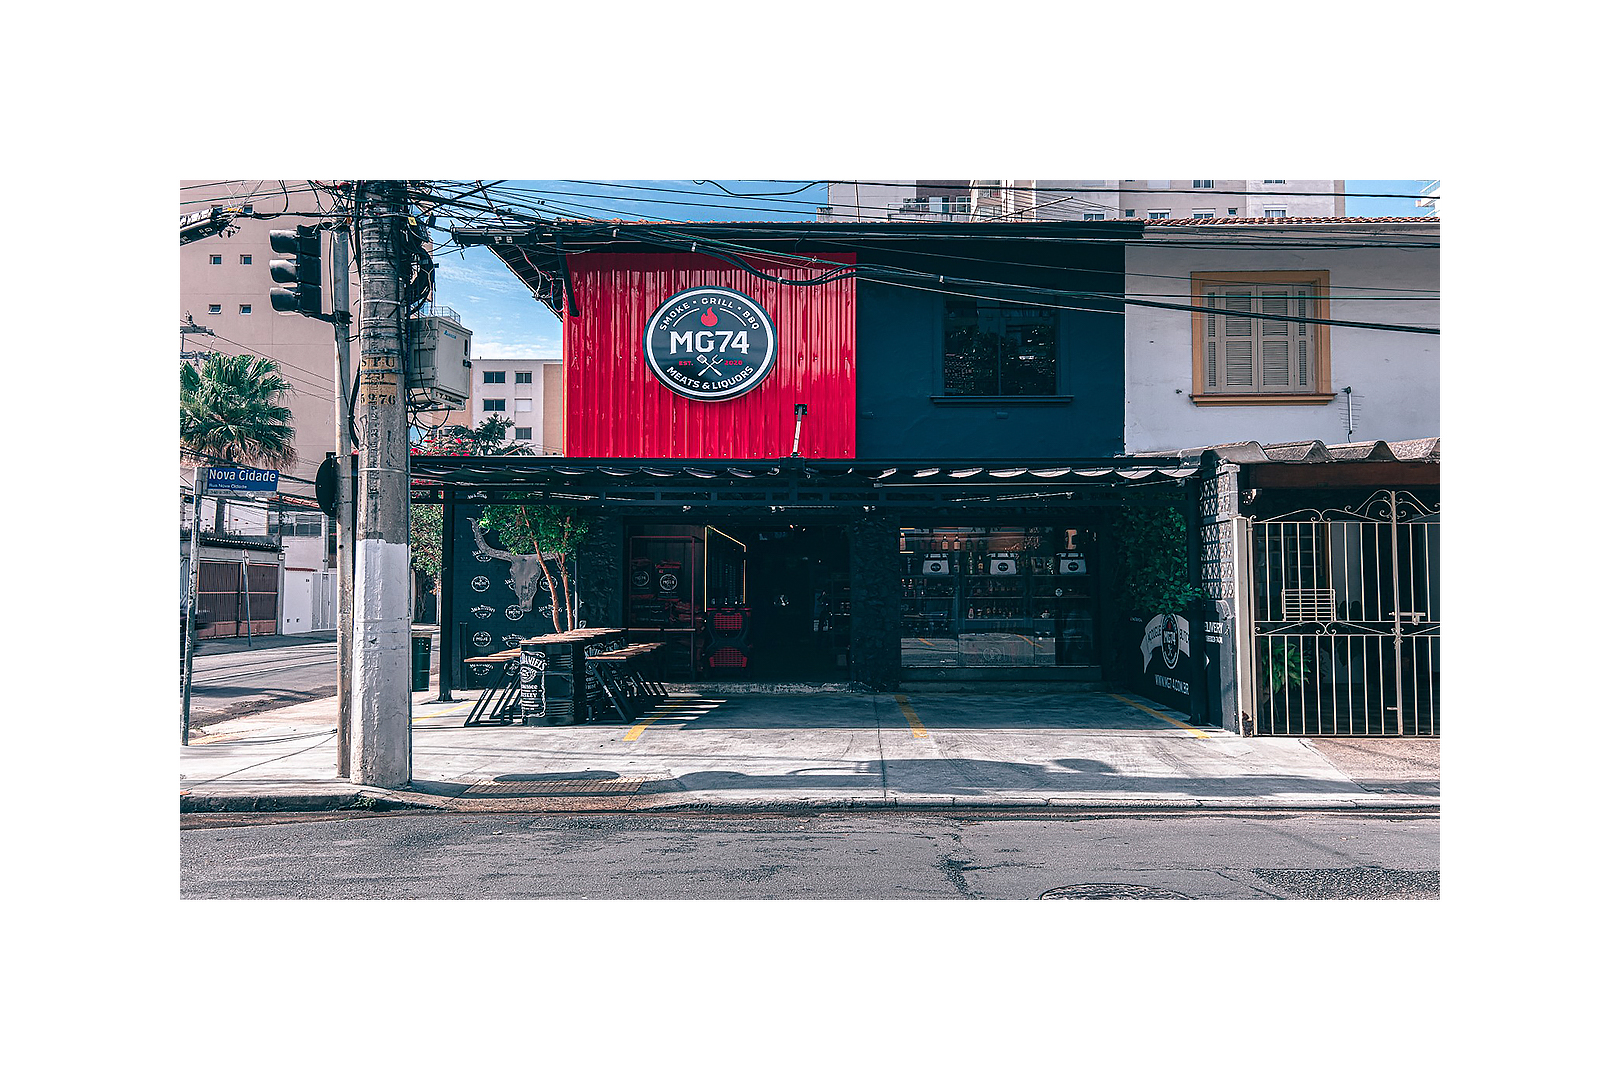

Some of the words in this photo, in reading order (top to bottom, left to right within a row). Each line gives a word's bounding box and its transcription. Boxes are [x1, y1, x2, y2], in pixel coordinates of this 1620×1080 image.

[659, 301, 691, 331] SMOKE
[701, 297, 734, 309] GRILL
[742, 308, 760, 330] BBQ
[669, 331, 751, 355] MG74
[666, 366, 701, 388] MEATS
[701, 381, 711, 390] &
[711, 365, 754, 390] LIQUORS
[208, 468, 236, 480] Nova
[238, 469, 276, 482] Cidade
